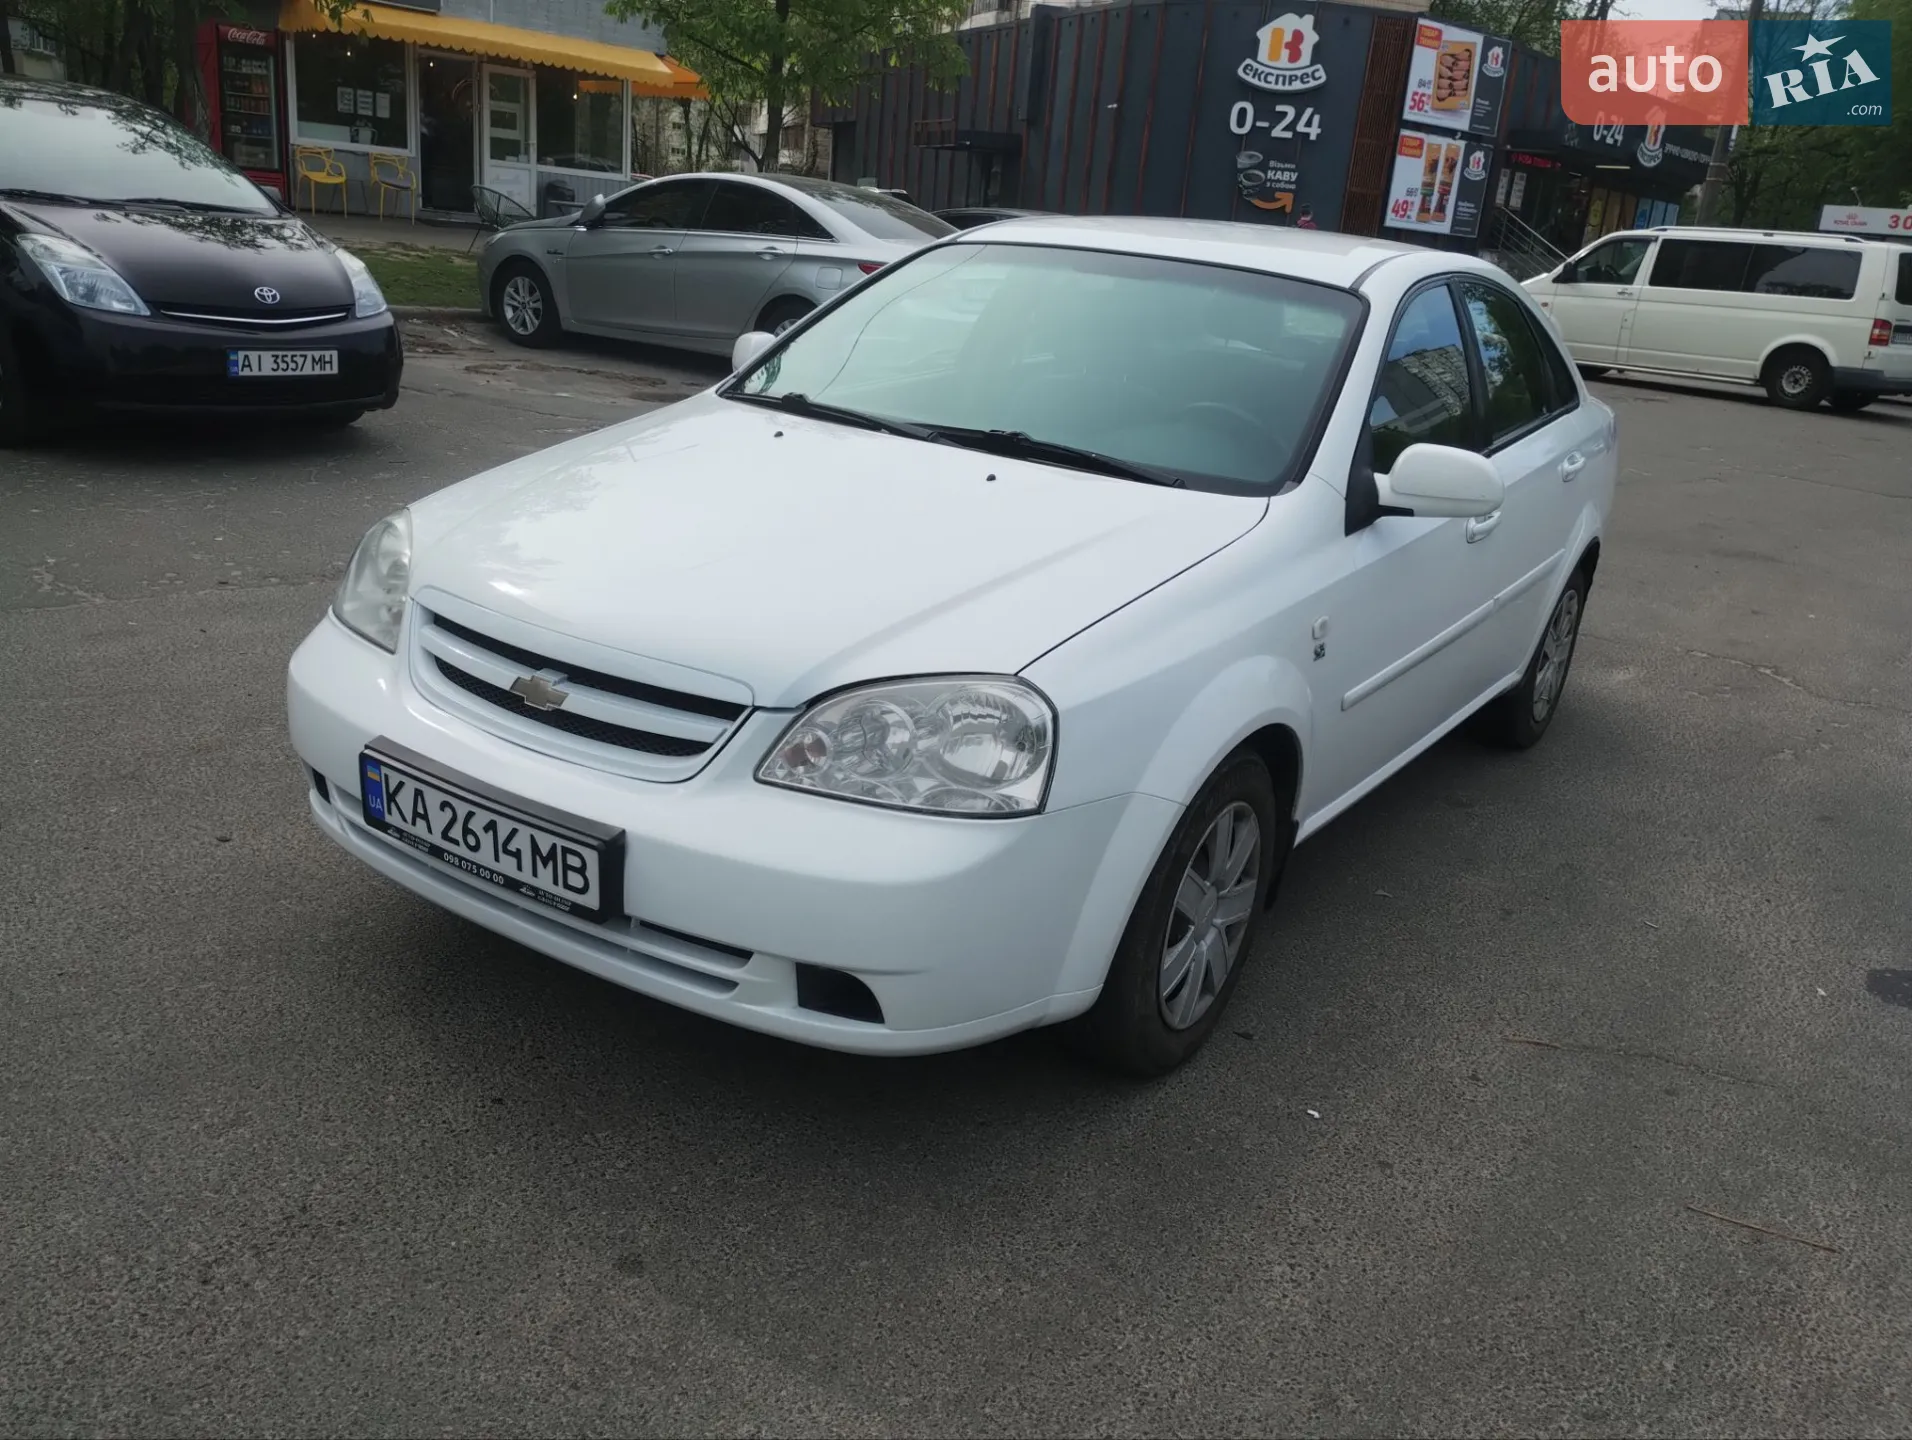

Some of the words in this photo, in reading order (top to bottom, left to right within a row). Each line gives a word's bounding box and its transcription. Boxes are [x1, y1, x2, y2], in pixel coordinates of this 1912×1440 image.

[1242, 63, 1322, 87] експрес
[1229, 101, 1322, 141] 0-24
[1267, 170, 1298, 182] КАВУ
[270, 354, 308, 372] 3557
[369, 794, 383, 811] UA
[461, 860, 477, 874] 075
[479, 867, 491, 879] 00
[492, 873, 504, 885] 00
